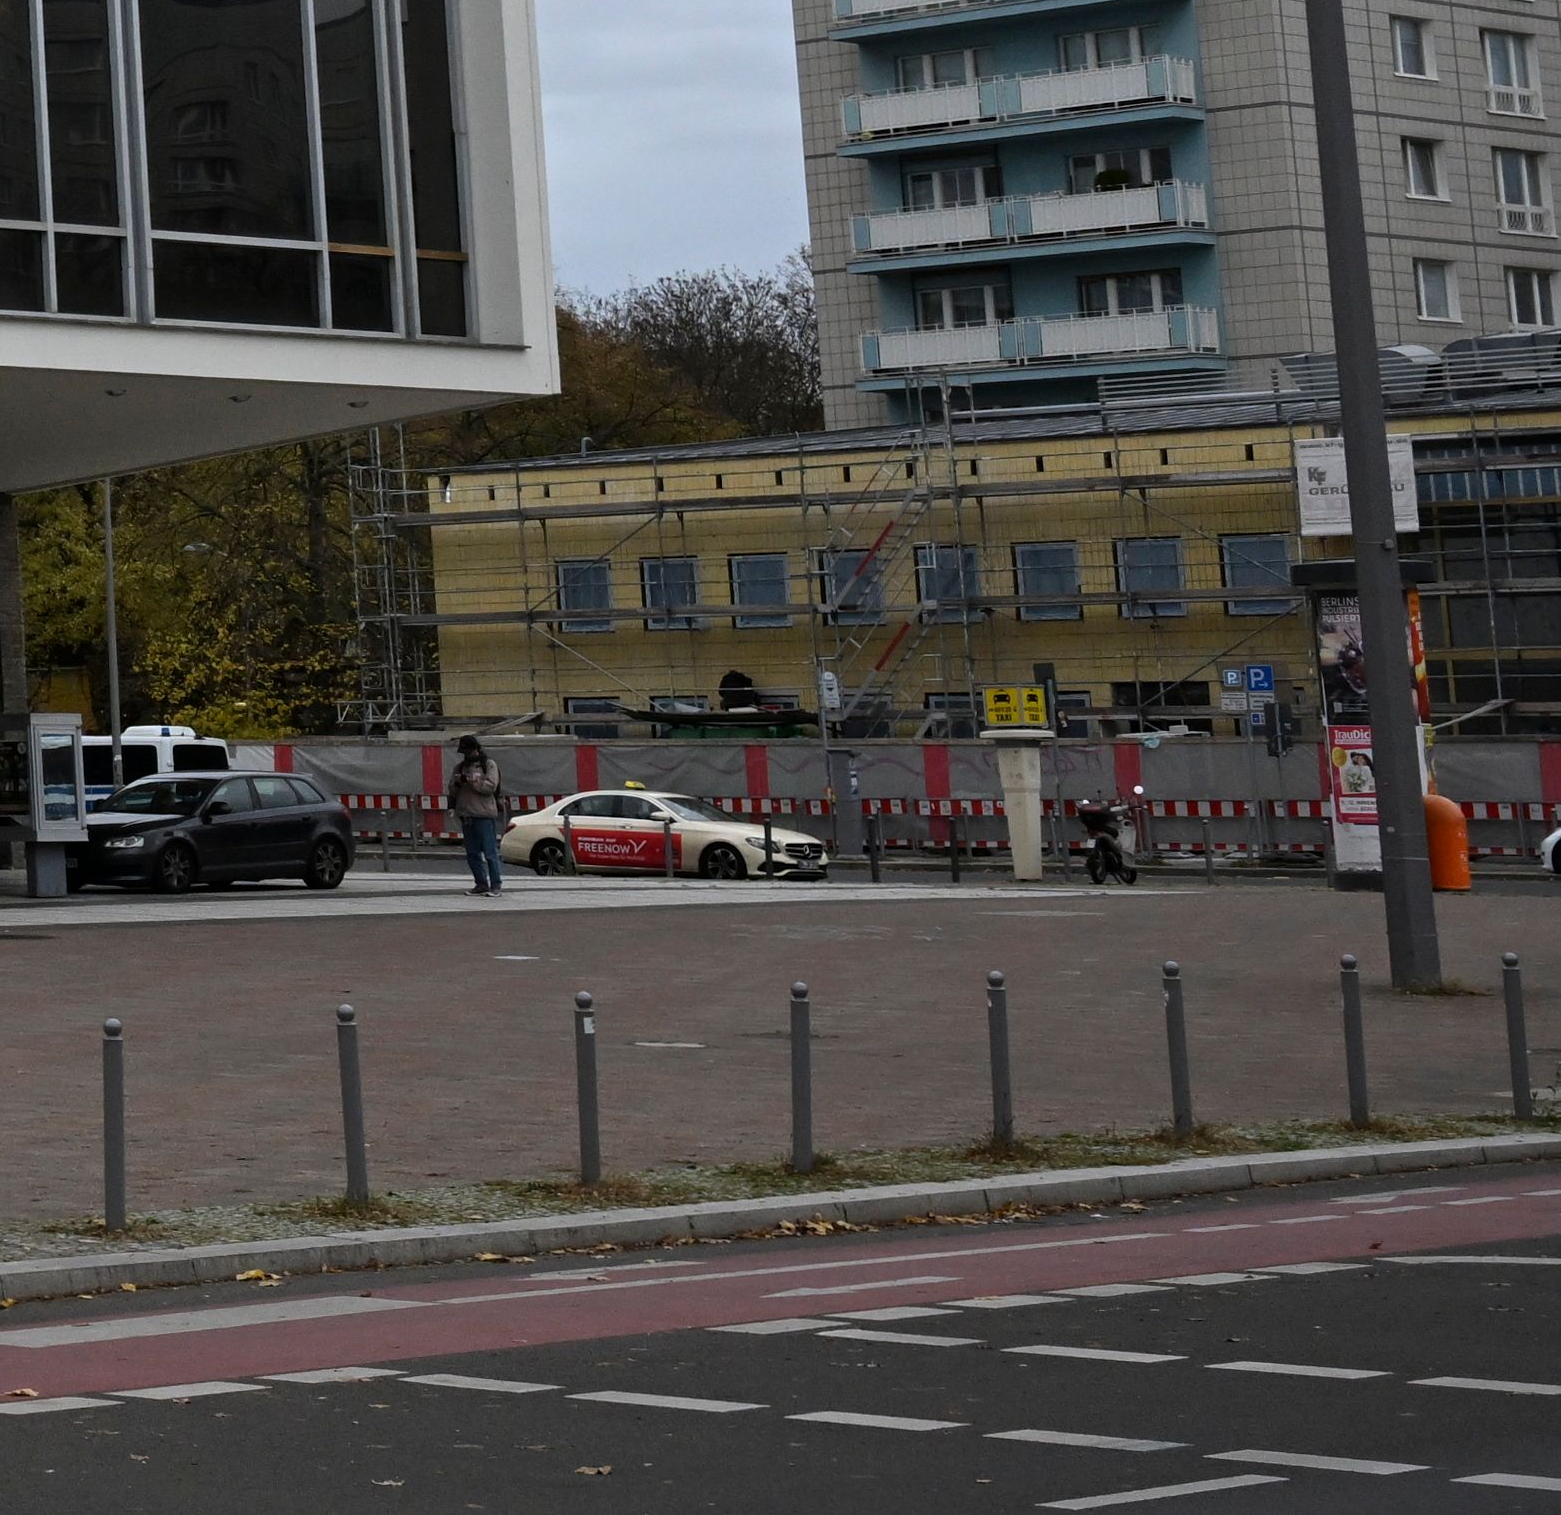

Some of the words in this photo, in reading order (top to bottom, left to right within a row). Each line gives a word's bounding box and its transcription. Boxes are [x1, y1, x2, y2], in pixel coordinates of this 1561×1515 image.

[1249, 668, 1265, 689] P
[995, 713, 1012, 722] TAXI
[577, 842, 631, 854] FREENOW
